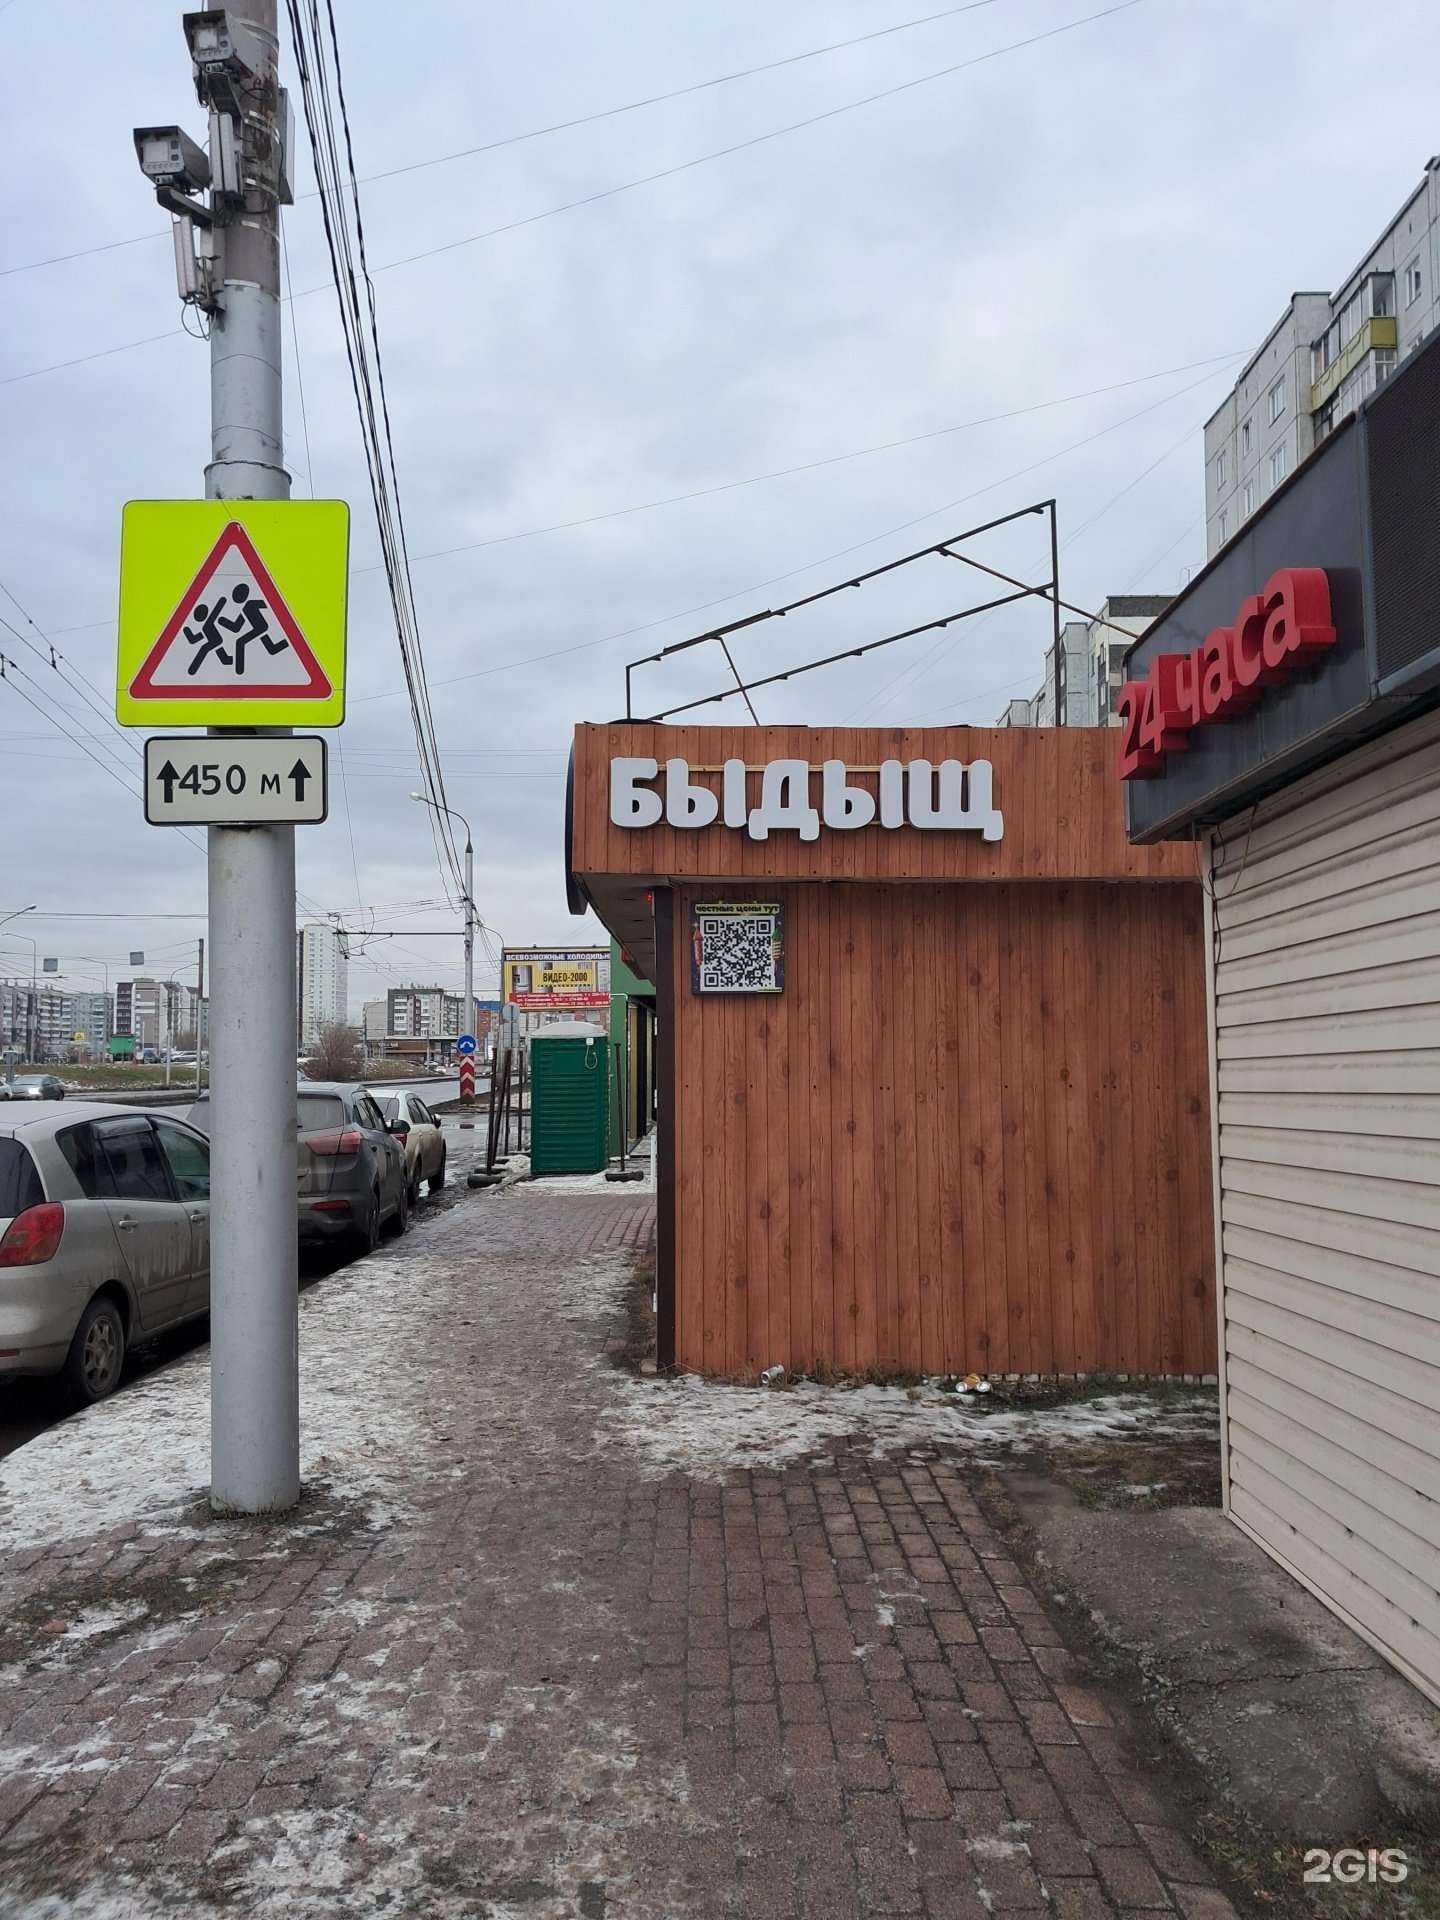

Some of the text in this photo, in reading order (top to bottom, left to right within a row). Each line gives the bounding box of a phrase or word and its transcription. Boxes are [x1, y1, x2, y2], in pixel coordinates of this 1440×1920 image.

[1118, 567, 1335, 780] 24 часа
[178, 764, 247, 795] 450
[610, 757, 1004, 841] БЫДЫЩ
[543, 972, 588, 983] ВИДЕО-2000
